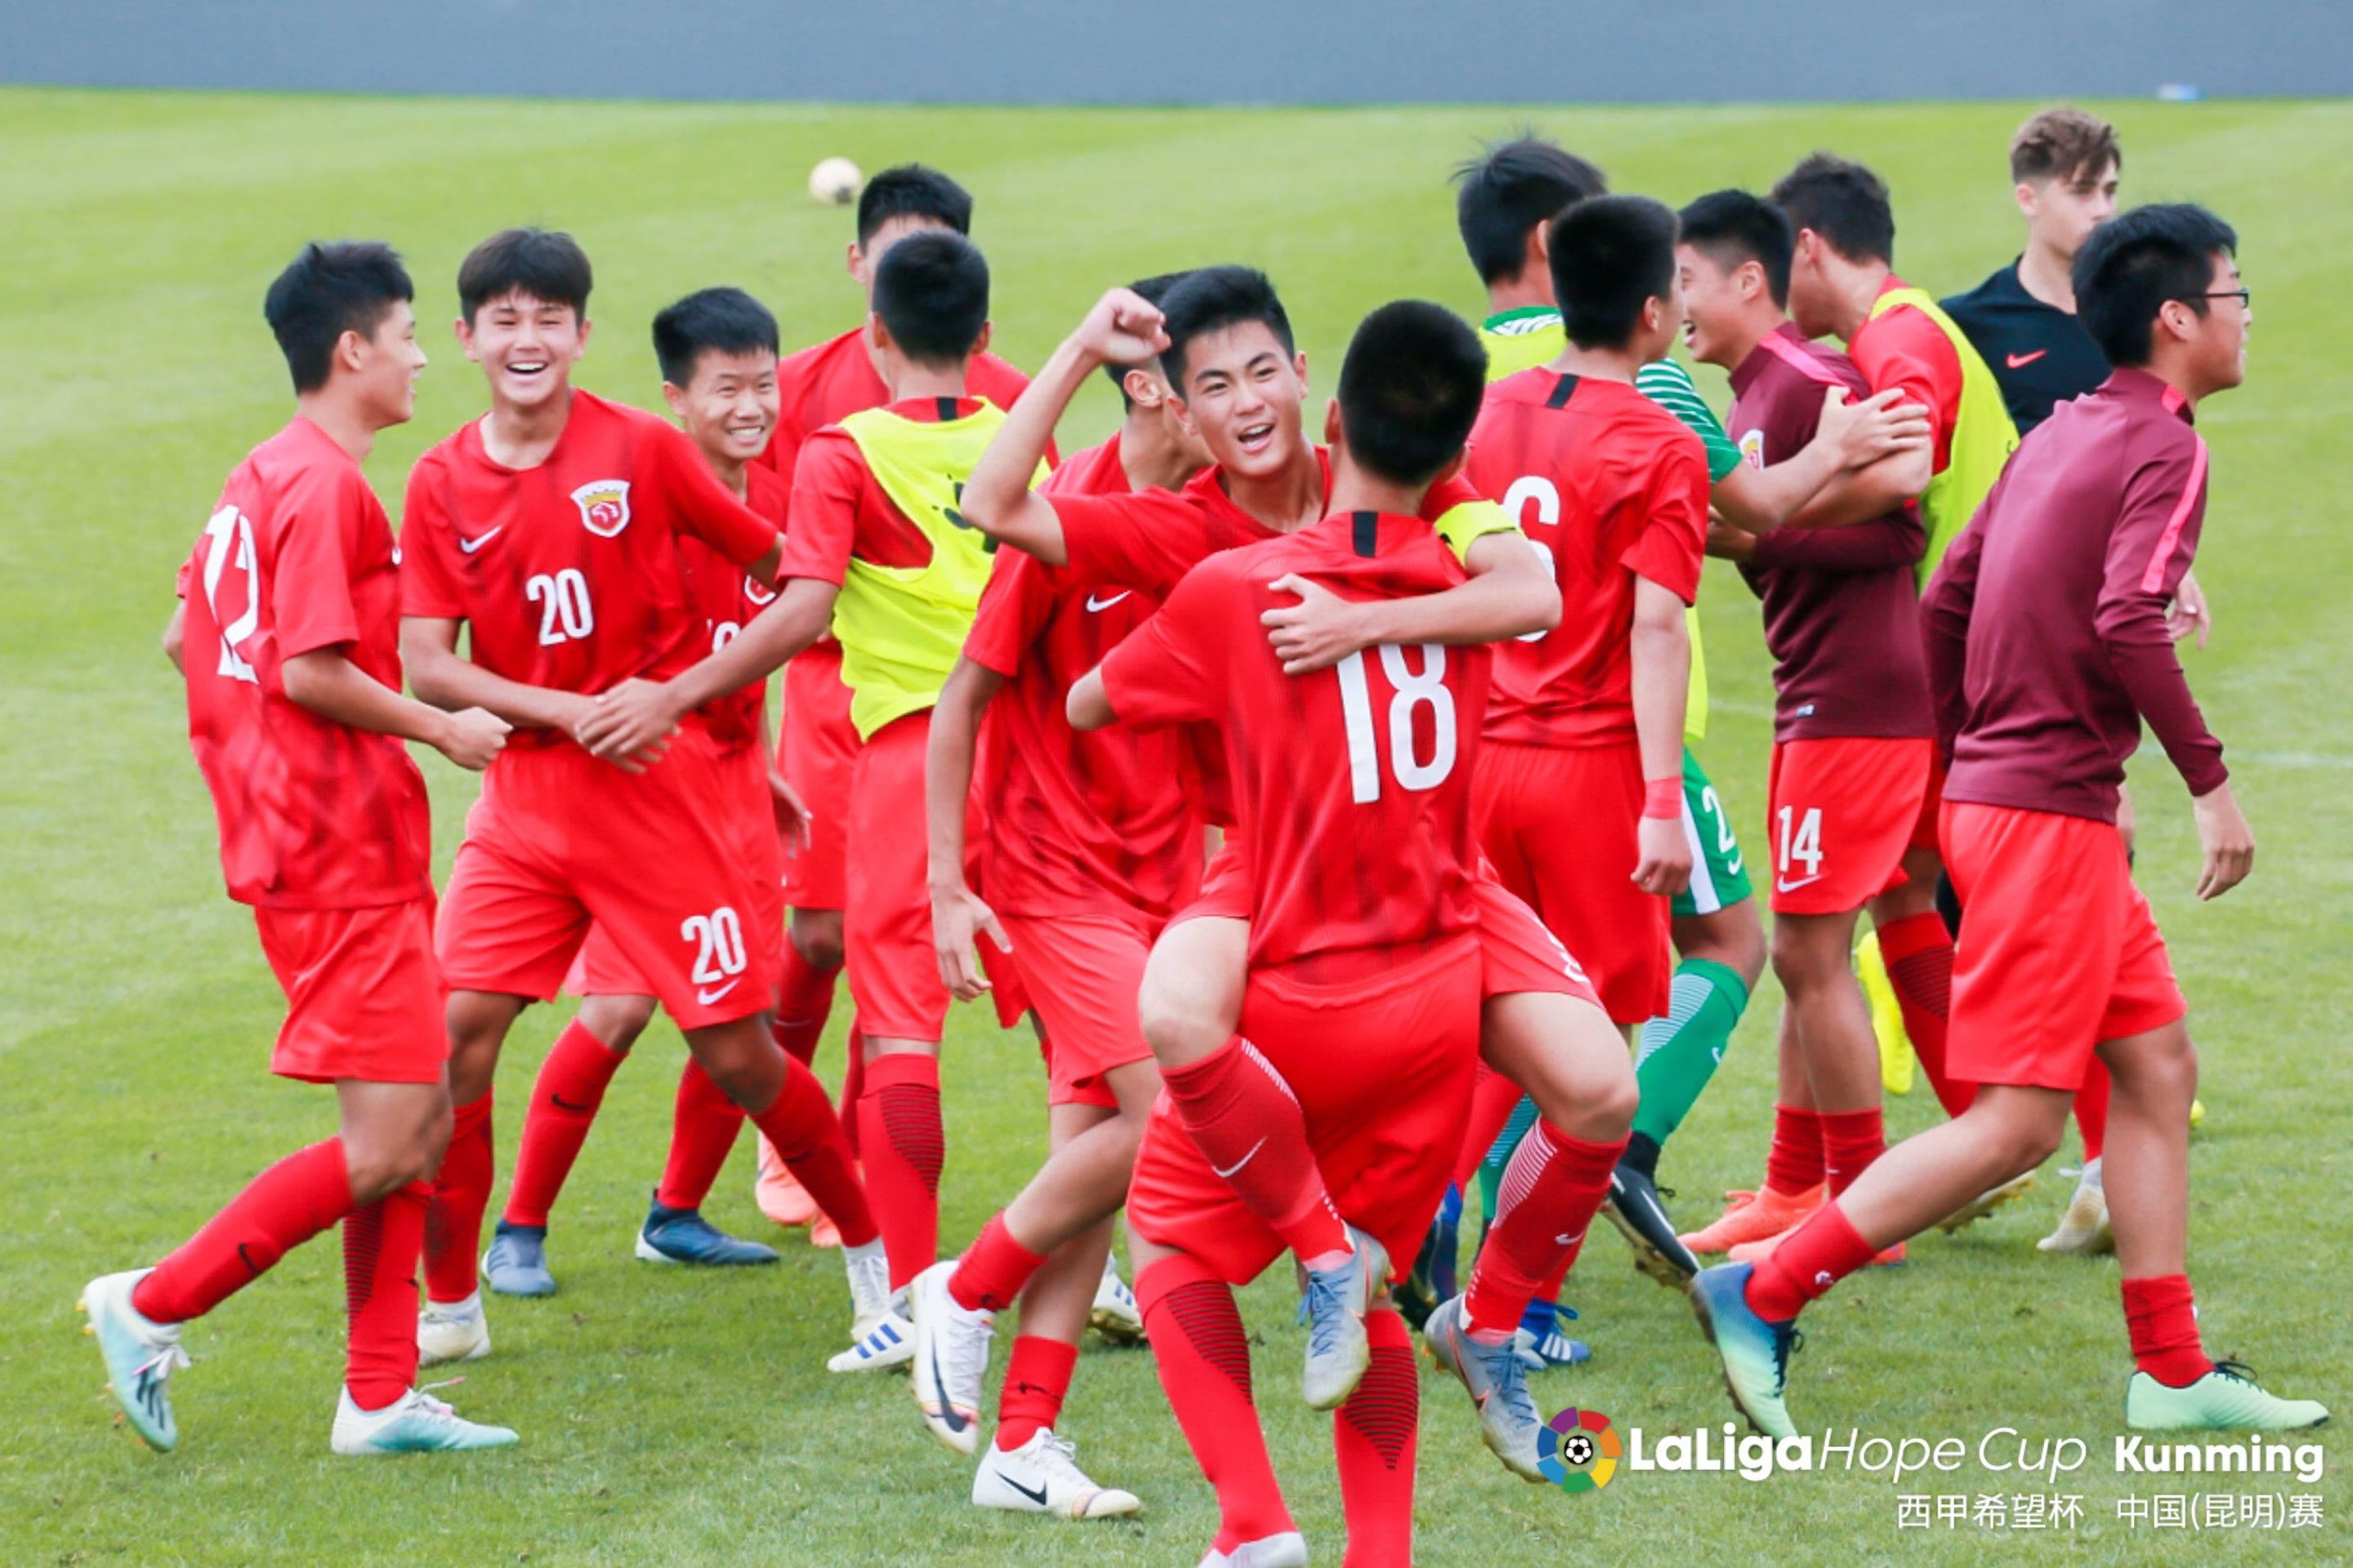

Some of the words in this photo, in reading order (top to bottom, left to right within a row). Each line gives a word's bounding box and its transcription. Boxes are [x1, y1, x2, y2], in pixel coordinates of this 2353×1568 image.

[526, 569, 593, 646] 20
[1337, 644, 1457, 804] 18
[1777, 805, 1823, 876] 14
[681, 907, 747, 984] 20
